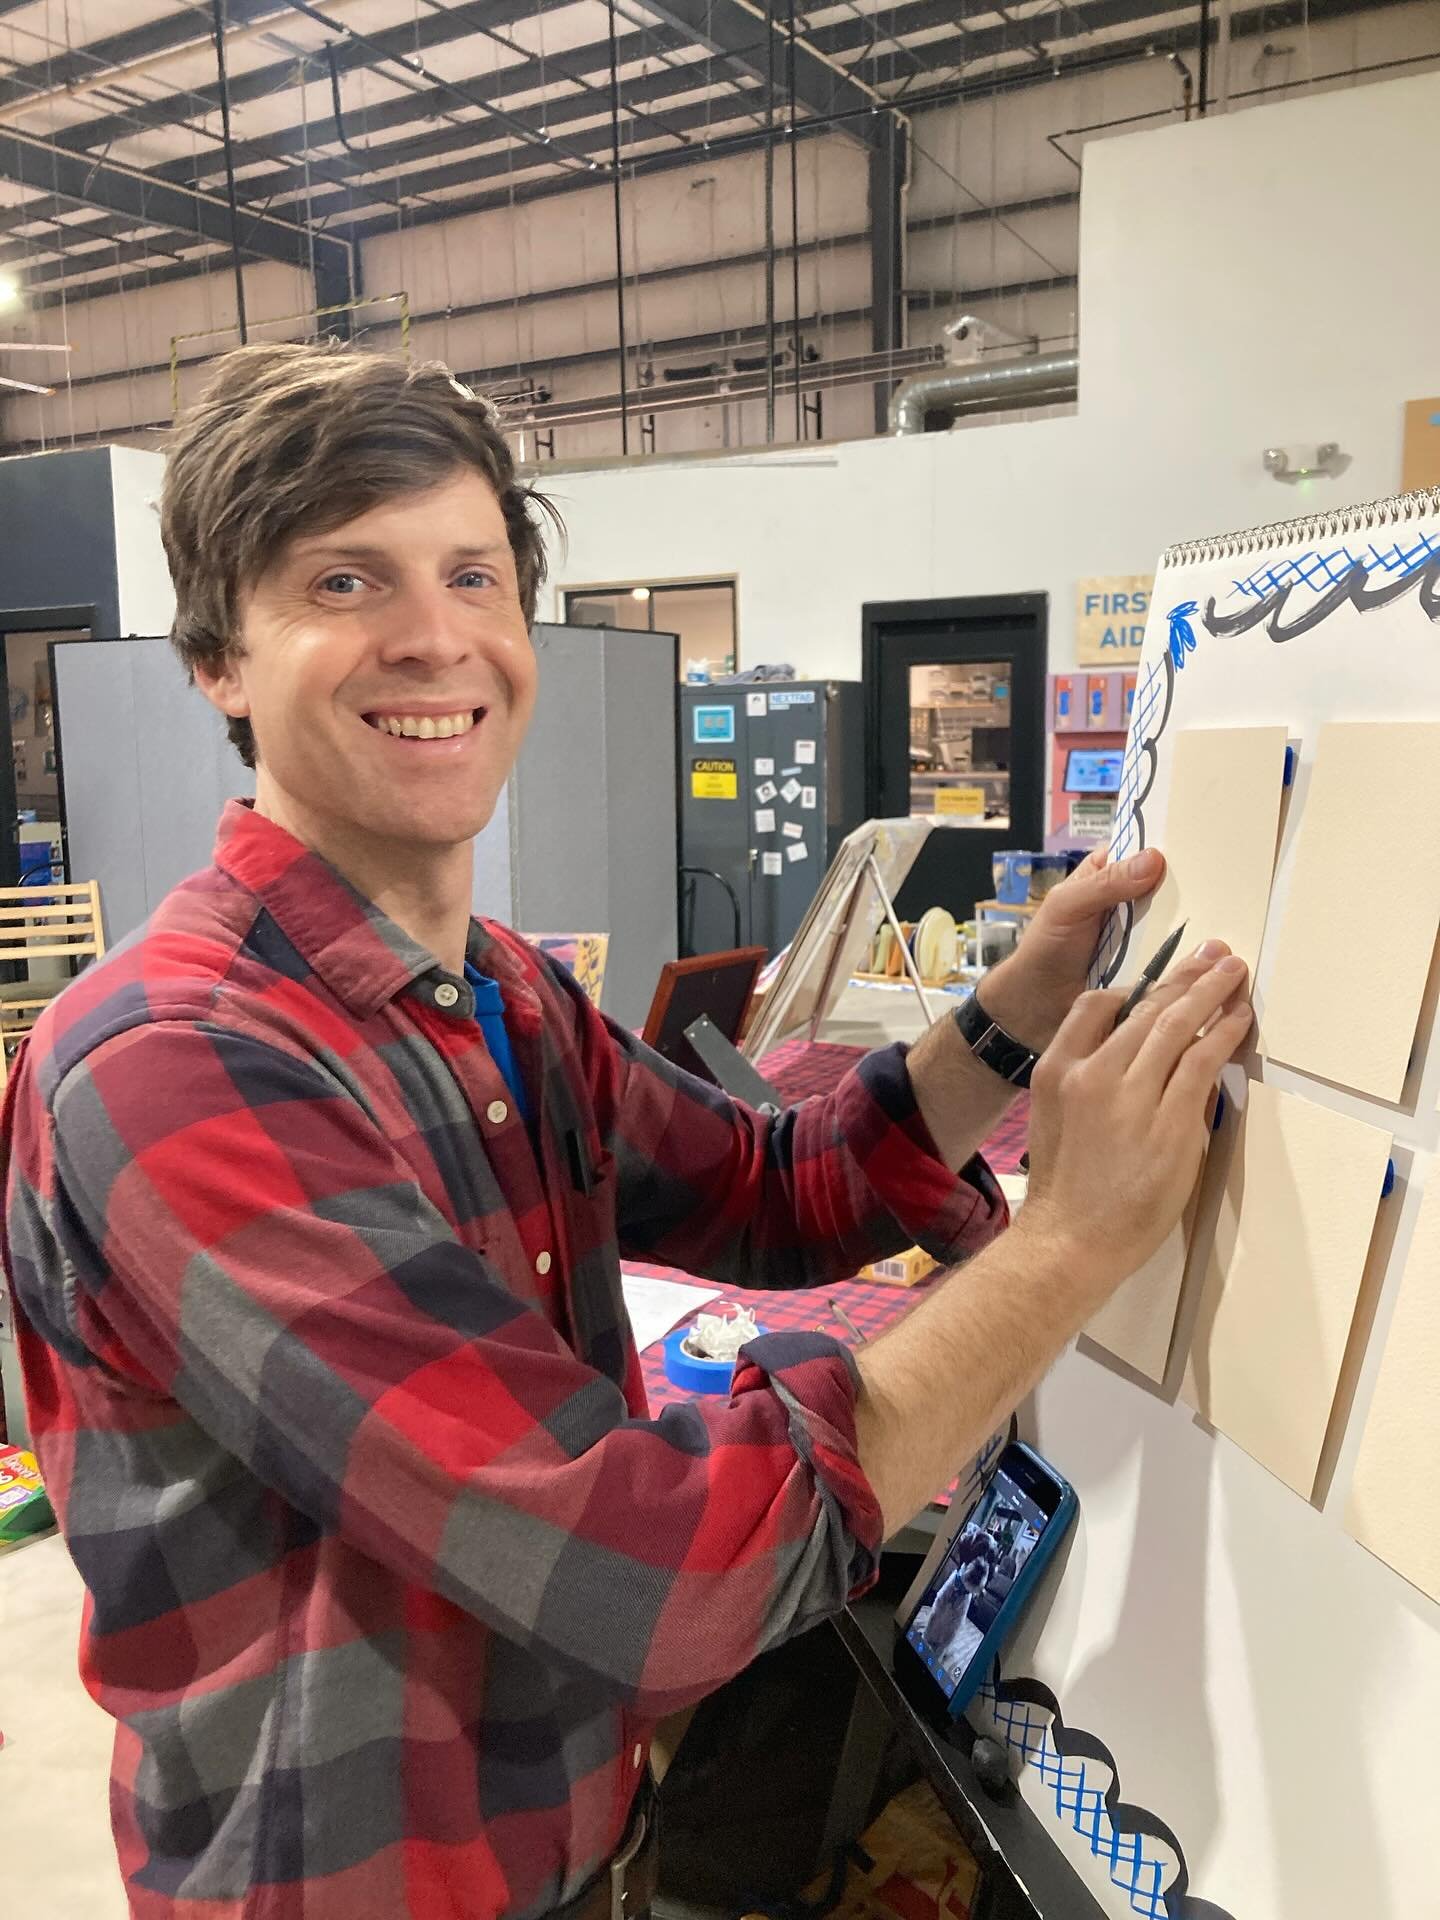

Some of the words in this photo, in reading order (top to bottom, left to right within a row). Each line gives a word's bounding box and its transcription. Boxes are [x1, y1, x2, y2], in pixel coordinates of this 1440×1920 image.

[1086, 592, 1157, 616] FIRS
[1100, 624, 1145, 648] AID
[695, 760, 734, 772] CAUTION
